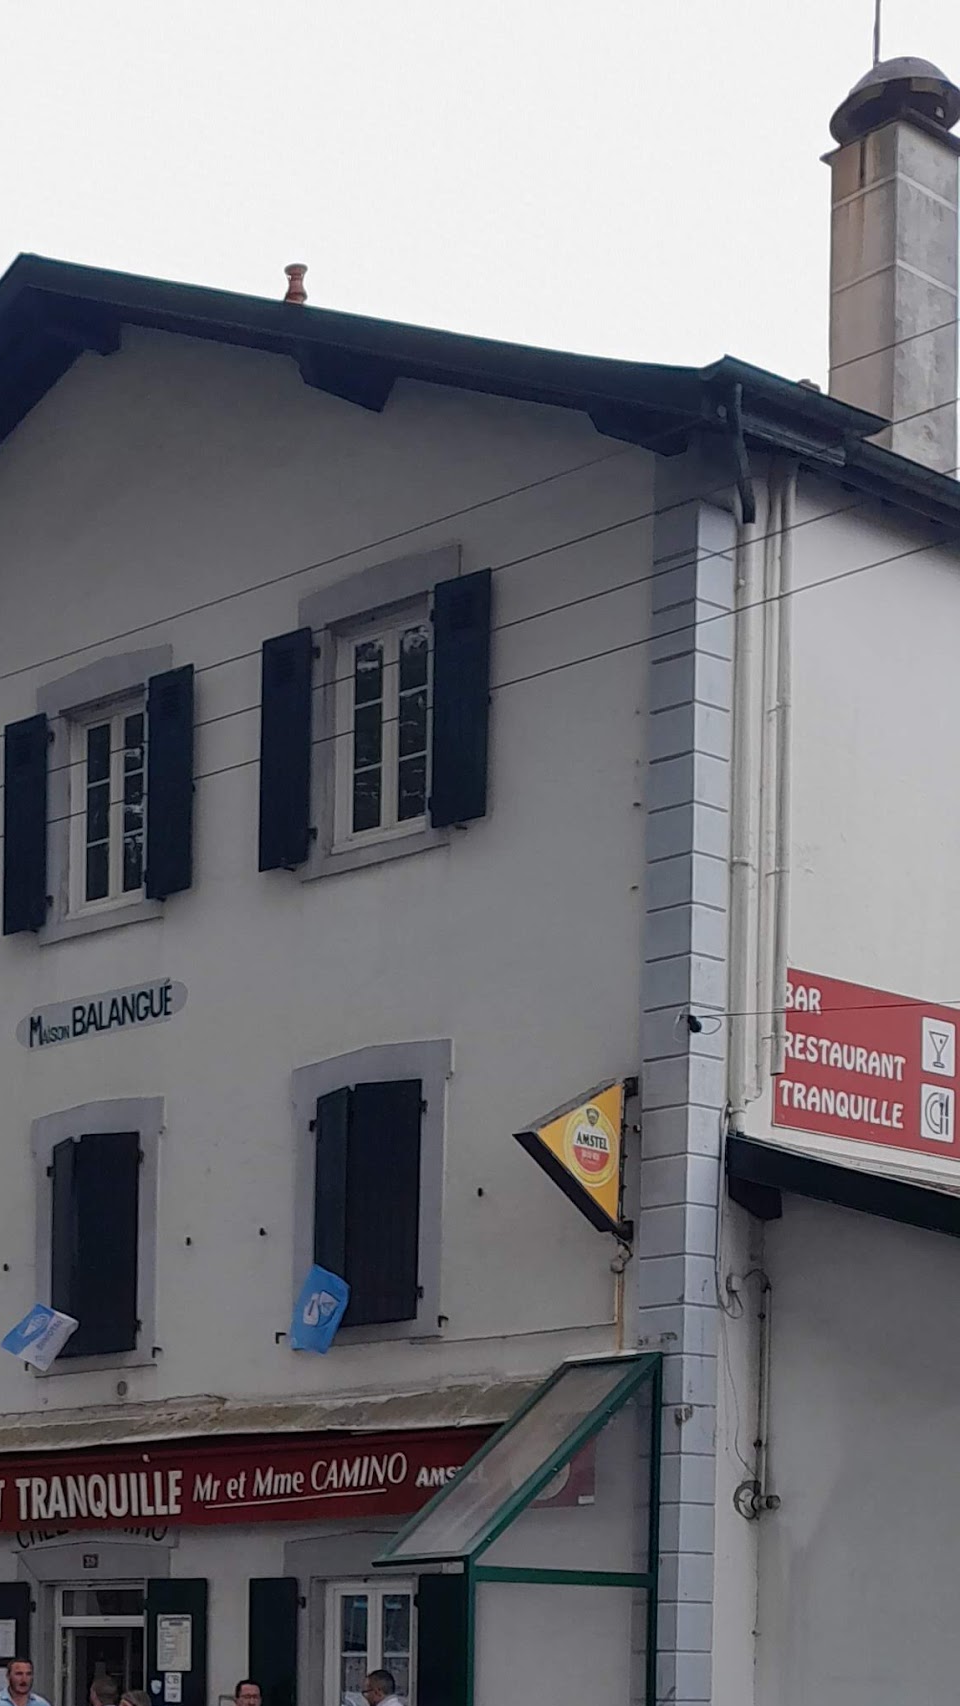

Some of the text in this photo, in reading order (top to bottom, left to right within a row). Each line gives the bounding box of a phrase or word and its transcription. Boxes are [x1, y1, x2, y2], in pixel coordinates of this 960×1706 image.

[786, 982, 822, 1015] BAR
[784, 1030, 906, 1081] RESTAURANT
[779, 1079, 904, 1129] TRANQUILLE
[576, 1131, 608, 1150] AMSTEL
[15, 1470, 183, 1520] TRANQUILLE
[193, 1473, 220, 1503] Mr
[226, 1471, 246, 1500] et
[253, 1465, 305, 1498] Mme
[310, 1452, 408, 1490] CAMINO
